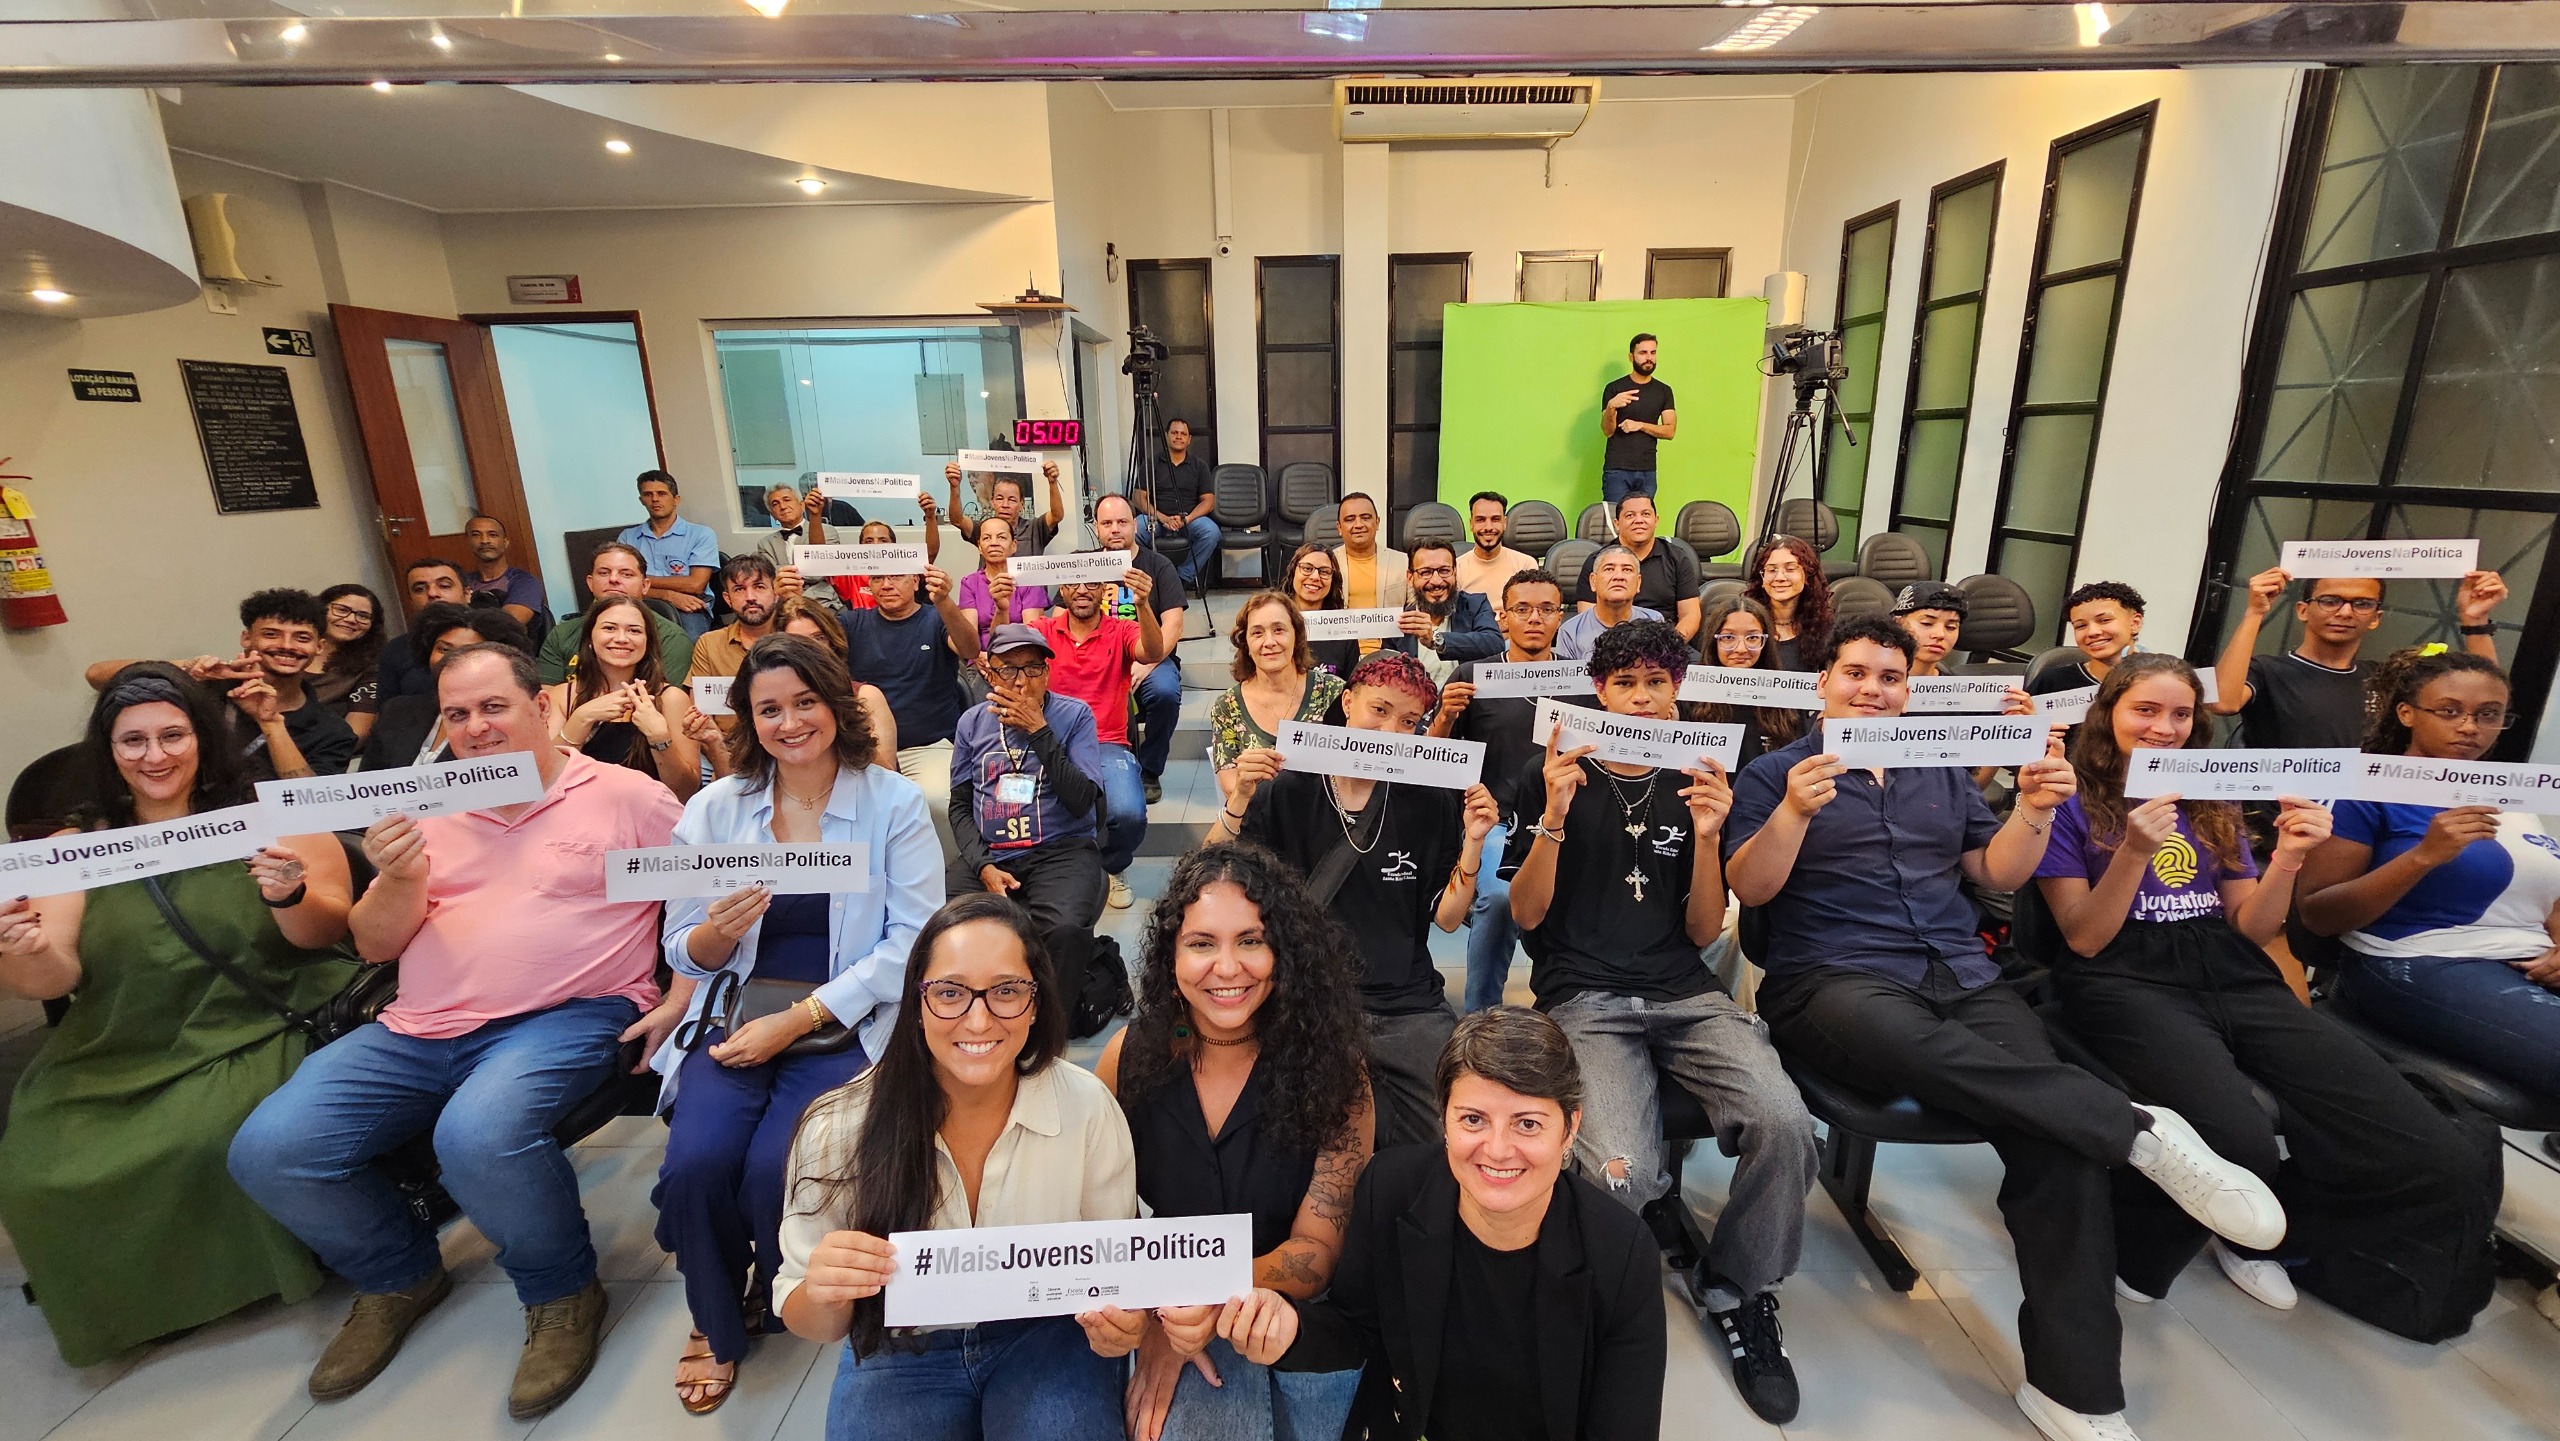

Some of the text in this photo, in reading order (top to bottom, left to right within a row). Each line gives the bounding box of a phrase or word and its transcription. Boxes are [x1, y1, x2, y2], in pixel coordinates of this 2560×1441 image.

[70, 374, 105, 384] LOTAÇÃO
[87, 387, 133, 397] 39 PESSOAS
[964, 453, 1037, 463] #MaisJovensNaPolítica
[824, 476, 913, 487] #MaisJovensNaPolítica
[803, 548, 918, 560] #MaisJovensNaPolítica
[2297, 547, 2463, 559] #MaisJovensNaPolítica
[1016, 556, 1123, 572] #MaisJovensNaPolítica
[1305, 613, 1394, 626] aisJovensNaPolítica
[1485, 666, 1591, 681] #MaisJovensNaPo
[1911, 682, 2011, 694] JovensNaPolítica
[1550, 709, 1728, 748] #MaisJovensNaPolítica
[1842, 725, 2032, 743] #MaisJovensNaPolítica
[1292, 730, 1469, 765] #MaisJovensNaPolítica
[2148, 757, 2341, 774] #MaisJovensNaPolítica
[281, 763, 519, 807] #MaisJovensNaPolítica
[996, 817, 1031, 839] -SE
[0, 819, 247, 873] aisJovensNaPolítica
[626, 851, 852, 874] #MaisJovensNaPolítica
[914, 1232, 1226, 1276] #MaisJovensNaPolítica
